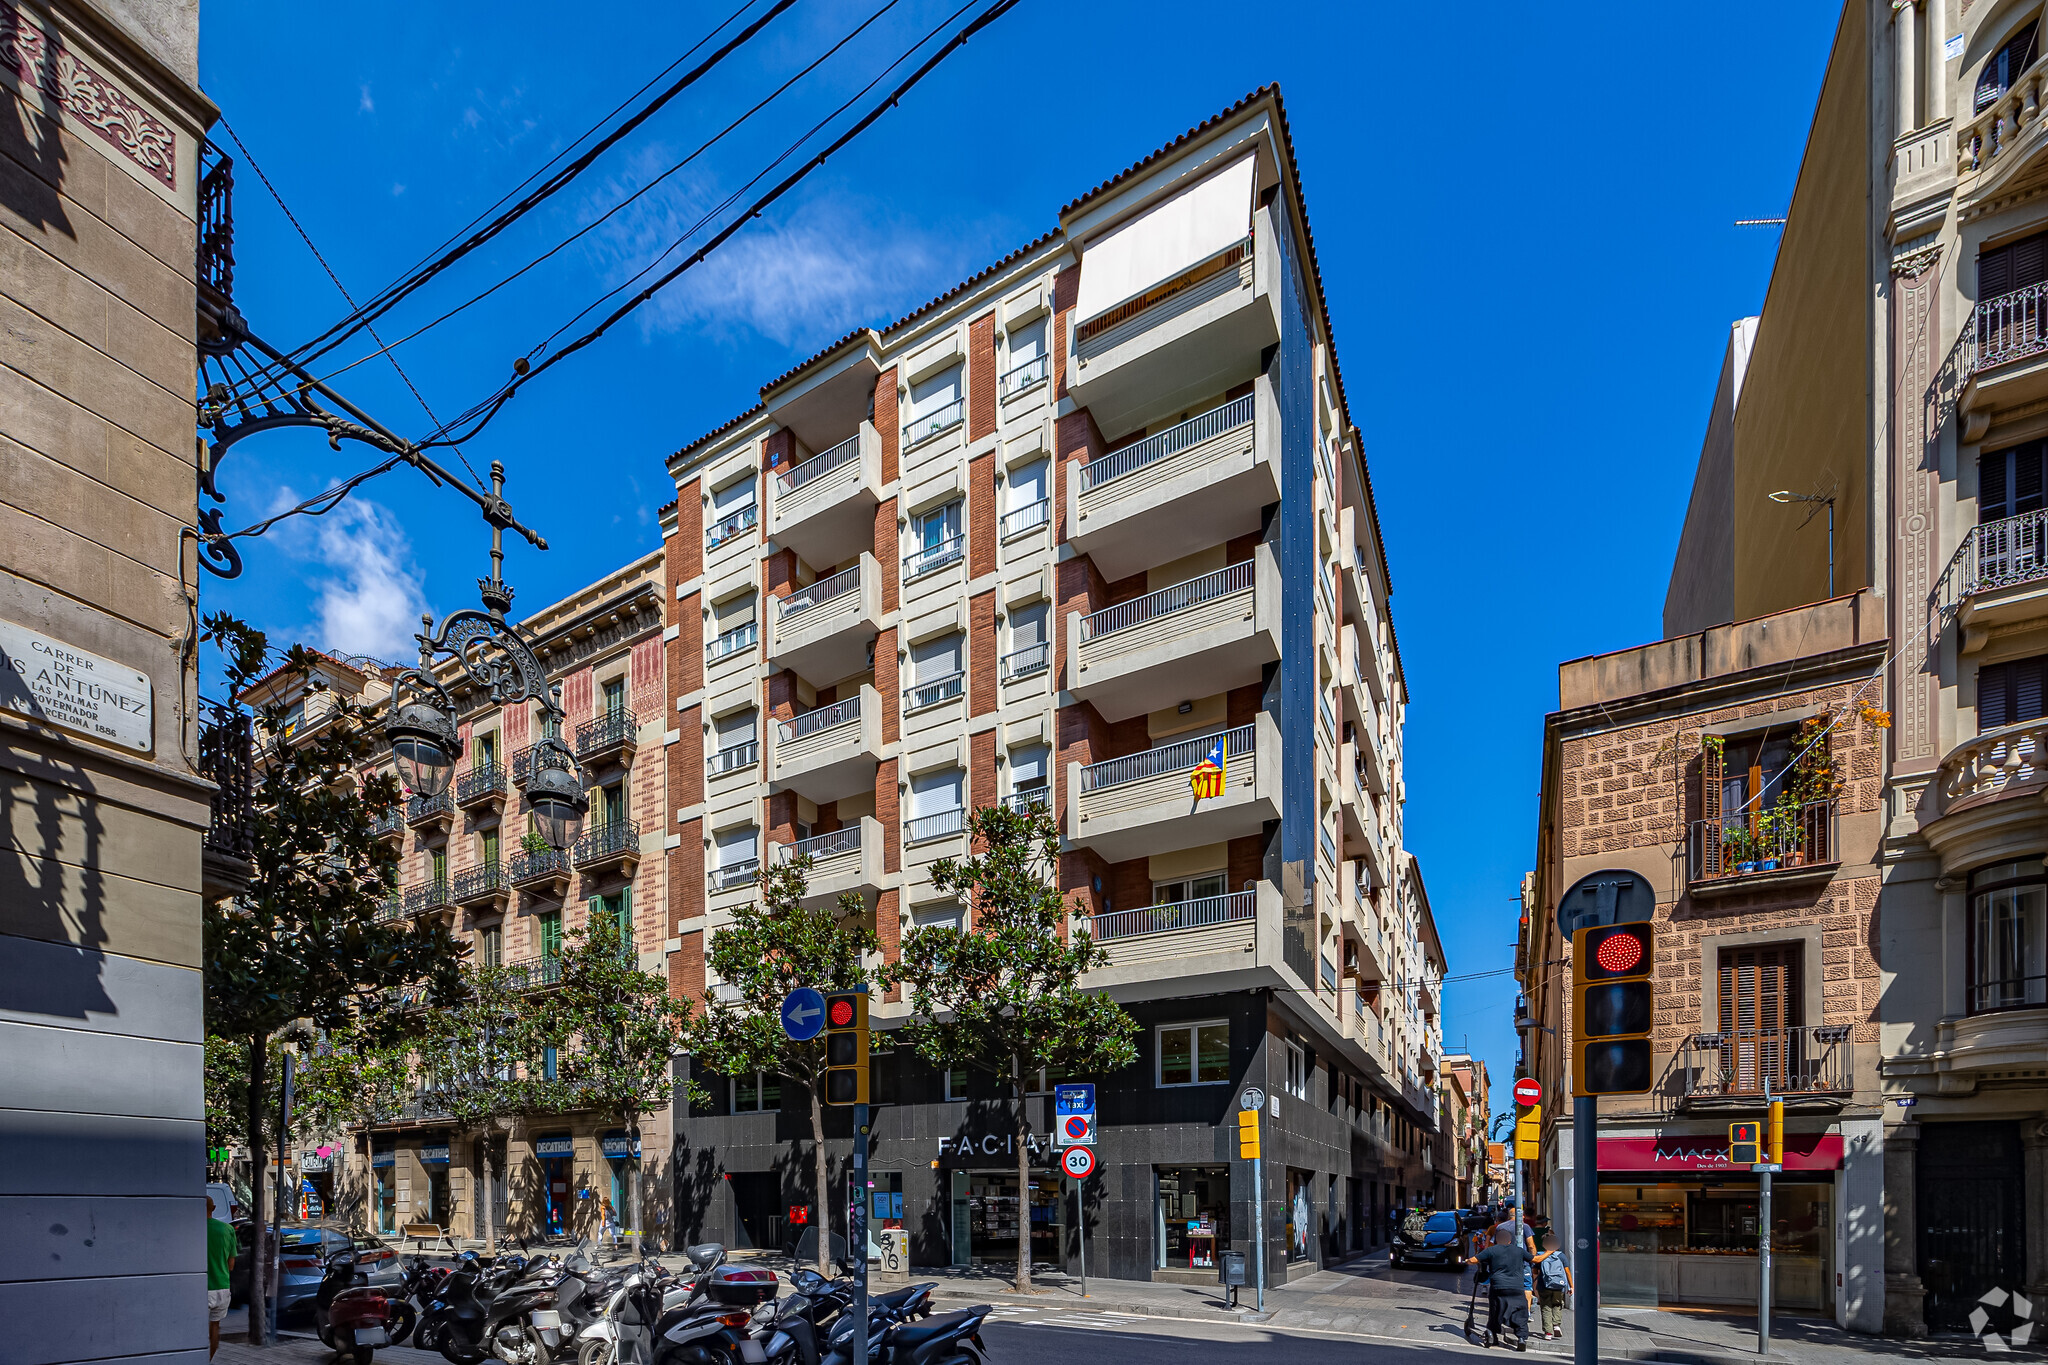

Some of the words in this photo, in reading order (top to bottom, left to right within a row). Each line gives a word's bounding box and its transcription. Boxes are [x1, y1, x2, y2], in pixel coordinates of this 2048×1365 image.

[31, 641, 94, 671] CARRER
[53, 660, 74, 676] DE
[31, 681, 52, 695] LAS
[57, 690, 99, 711] PALMAS
[31, 692, 99, 721] GOVERNADOR
[36, 668, 147, 718] ANTÚNEZ
[31, 702, 90, 729] BARCELONA
[95, 723, 117, 738] 1886
[1067, 1100, 1084, 1109] taxi
[536, 1141, 573, 1153] DECATHLO
[1069, 1156, 1088, 1167] 30
